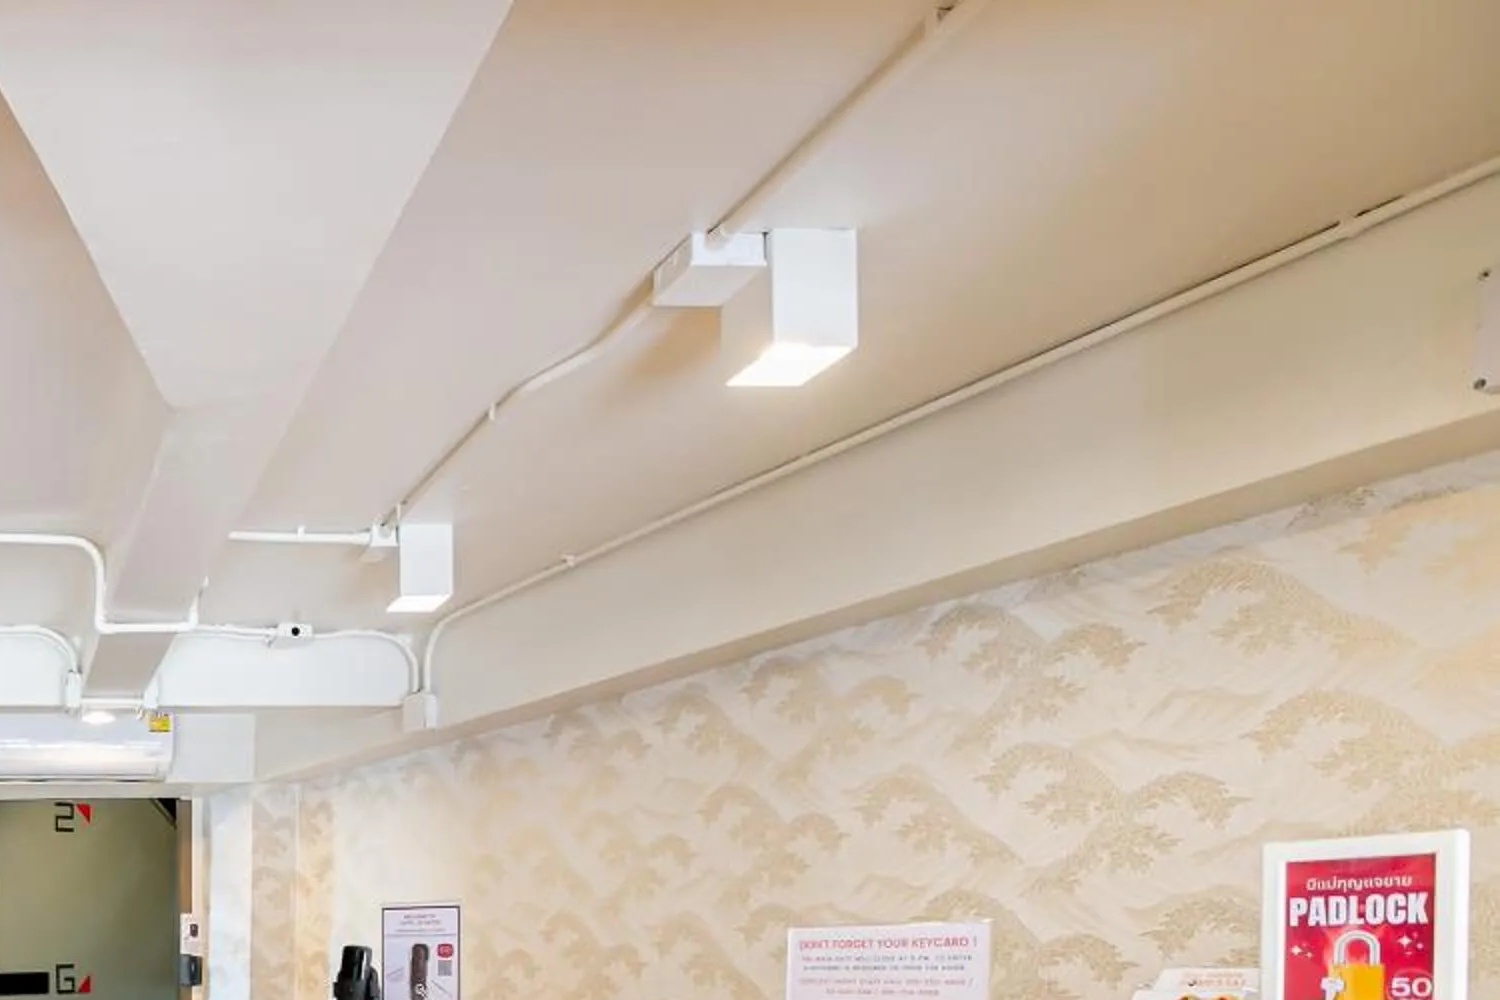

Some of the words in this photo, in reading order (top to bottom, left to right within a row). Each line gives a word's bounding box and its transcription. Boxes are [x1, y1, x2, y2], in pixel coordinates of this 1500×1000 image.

[54, 802, 75, 832] 2
[1289, 892, 1429, 927] PADLOCK
[832, 938, 874, 950] FORGET
[876, 937, 909, 949] YOUR
[911, 936, 970, 949] KEYCARD
[56, 963, 76, 994] G
[1391, 977, 1432, 997] 50
